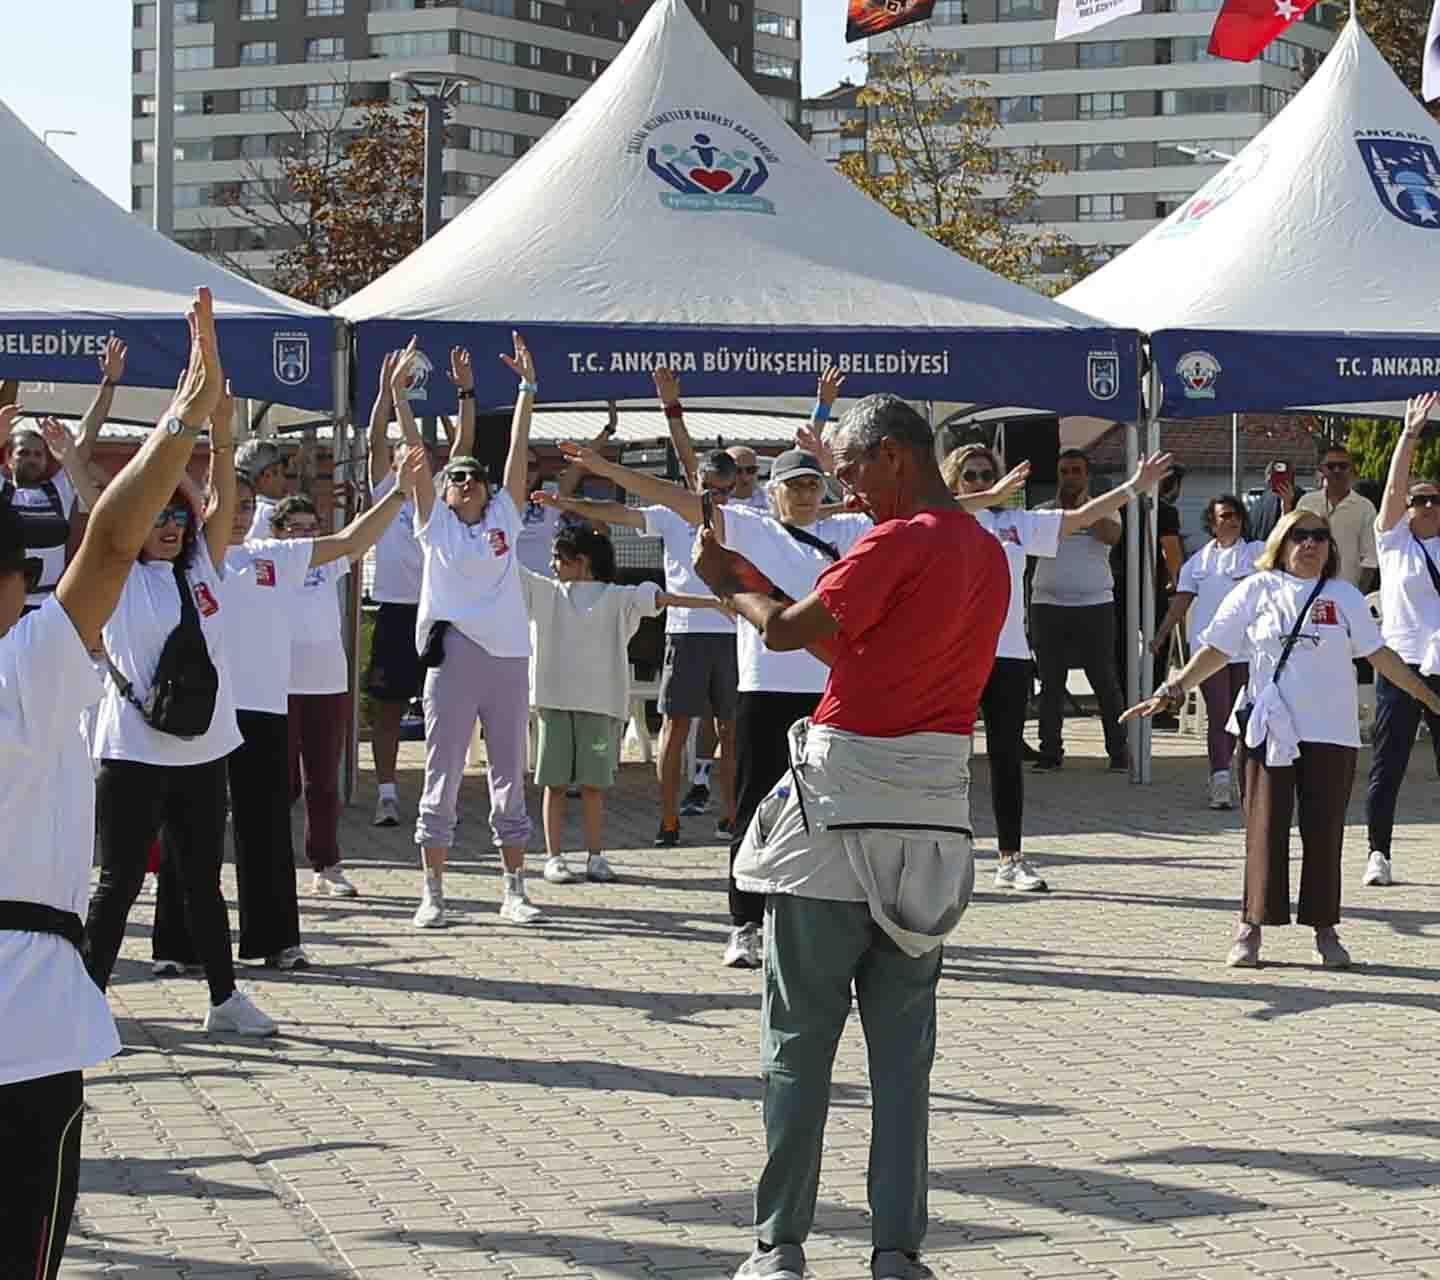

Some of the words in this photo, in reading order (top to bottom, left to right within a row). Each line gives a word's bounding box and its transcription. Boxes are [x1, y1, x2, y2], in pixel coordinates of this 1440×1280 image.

[568, 352, 604, 373] T.C.
[610, 351, 697, 373] ANKARA
[703, 346, 833, 376] BÜYÜKŞEHİR
[838, 349, 950, 375] BELEDİYESİ
[1335, 356, 1368, 377] T.C.
